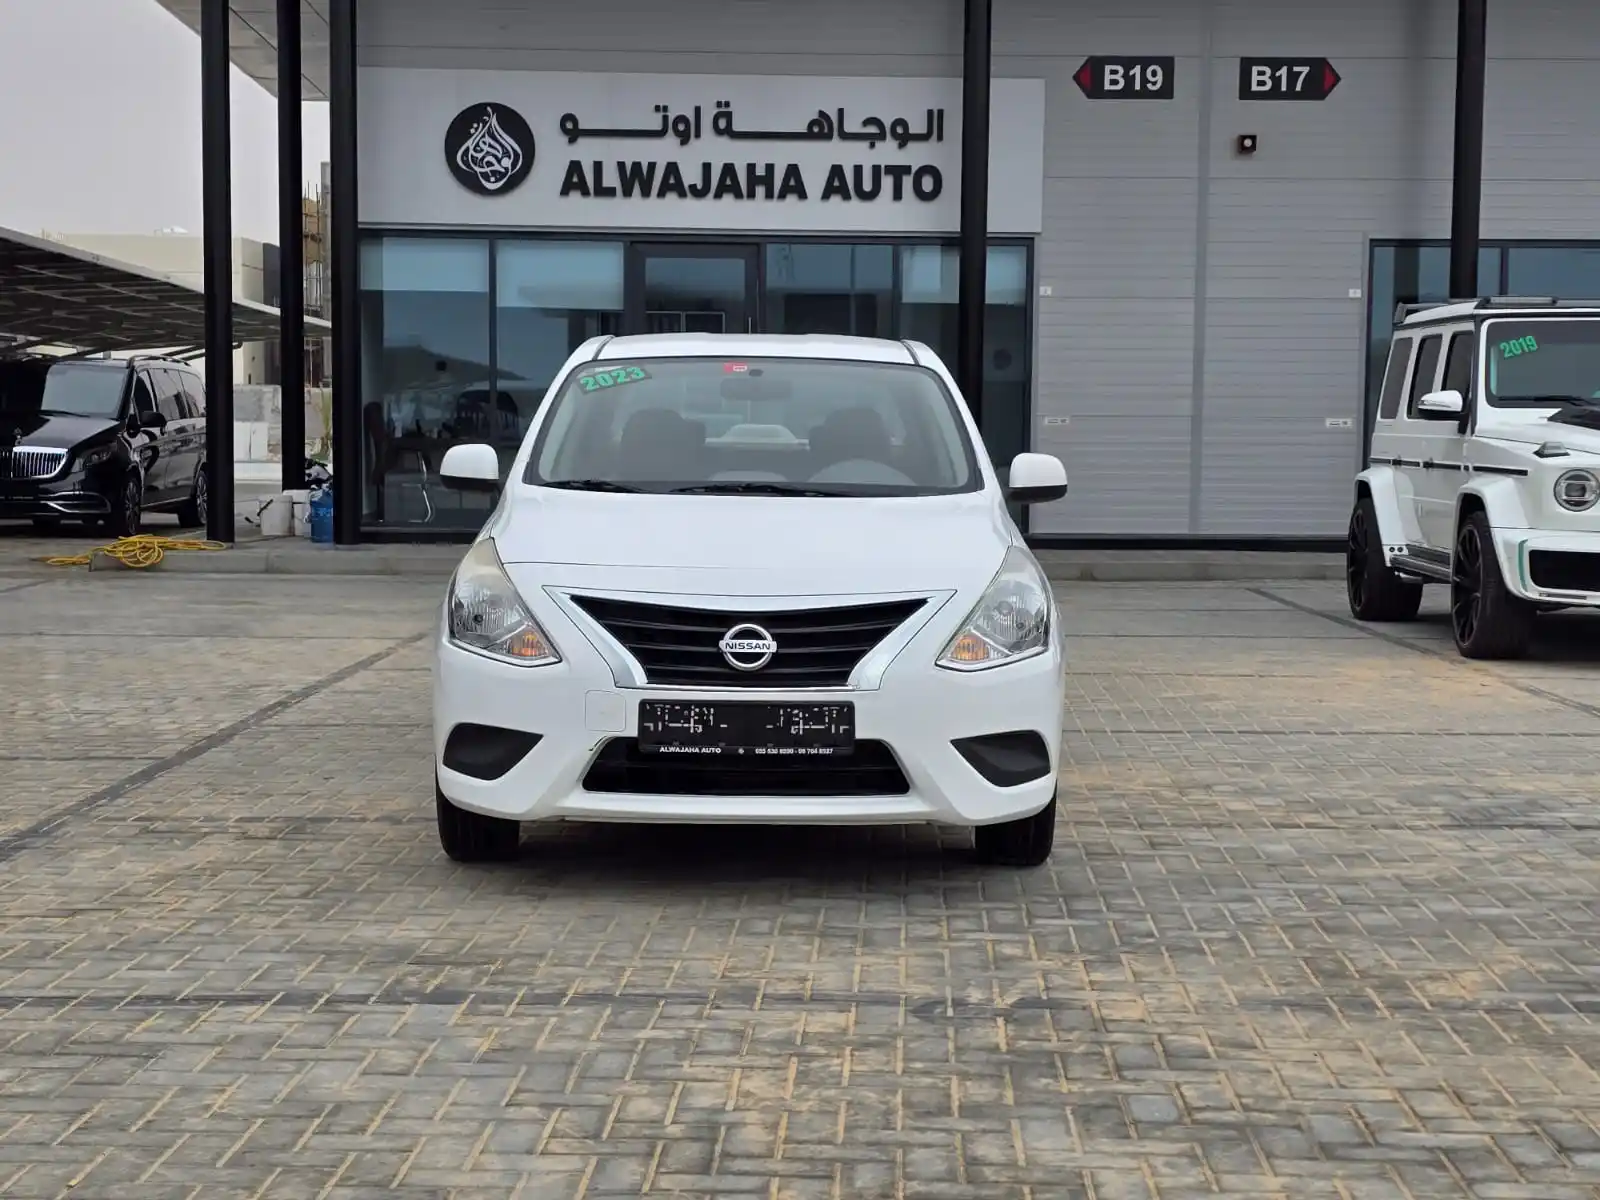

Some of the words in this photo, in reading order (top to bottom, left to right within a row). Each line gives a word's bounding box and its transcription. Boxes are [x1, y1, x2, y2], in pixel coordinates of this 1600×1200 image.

[1103, 64, 1164, 91] B19
[1250, 65, 1311, 92] B17
[559, 104, 702, 146] اوتو
[711, 100, 944, 149] الوجاهة
[559, 160, 808, 201] ALWAJAHA
[820, 164, 944, 202] AUTO
[1500, 335, 1538, 359] 2019
[580, 366, 646, 392] 2023
[725, 641, 771, 651] NISSAN
[659, 746, 700, 754] ALWAJAHA
